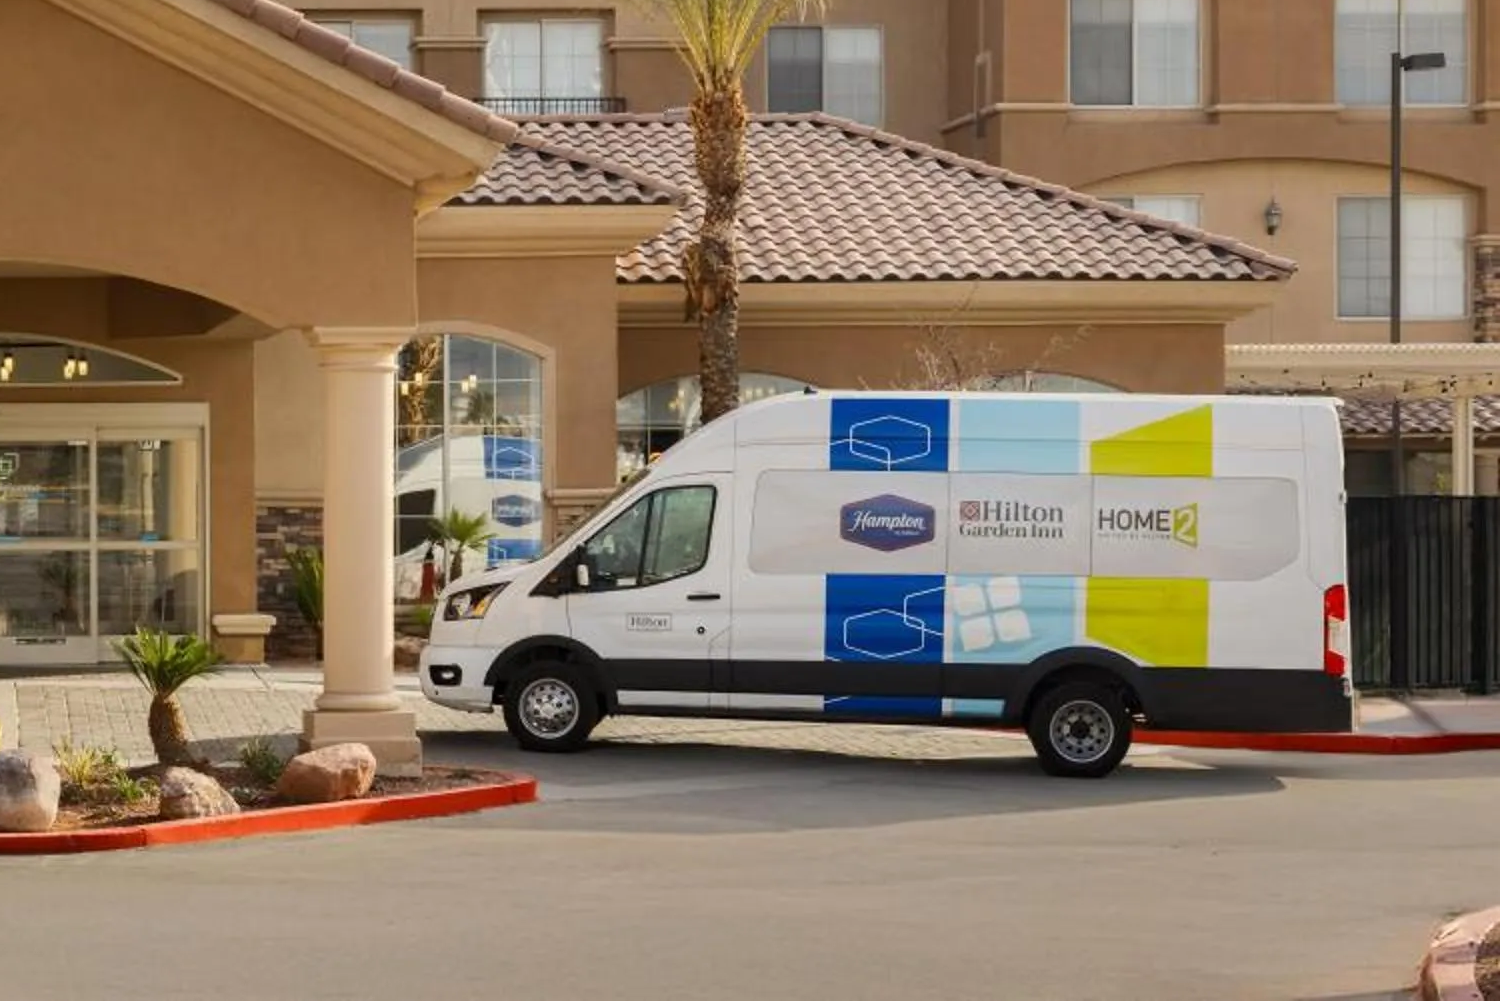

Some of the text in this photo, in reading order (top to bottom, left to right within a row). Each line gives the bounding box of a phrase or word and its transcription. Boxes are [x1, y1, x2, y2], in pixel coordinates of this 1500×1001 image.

[983, 501, 1063, 521] Hilton
[847, 510, 926, 533] Hampton
[959, 523, 1063, 538] Garden Inn
